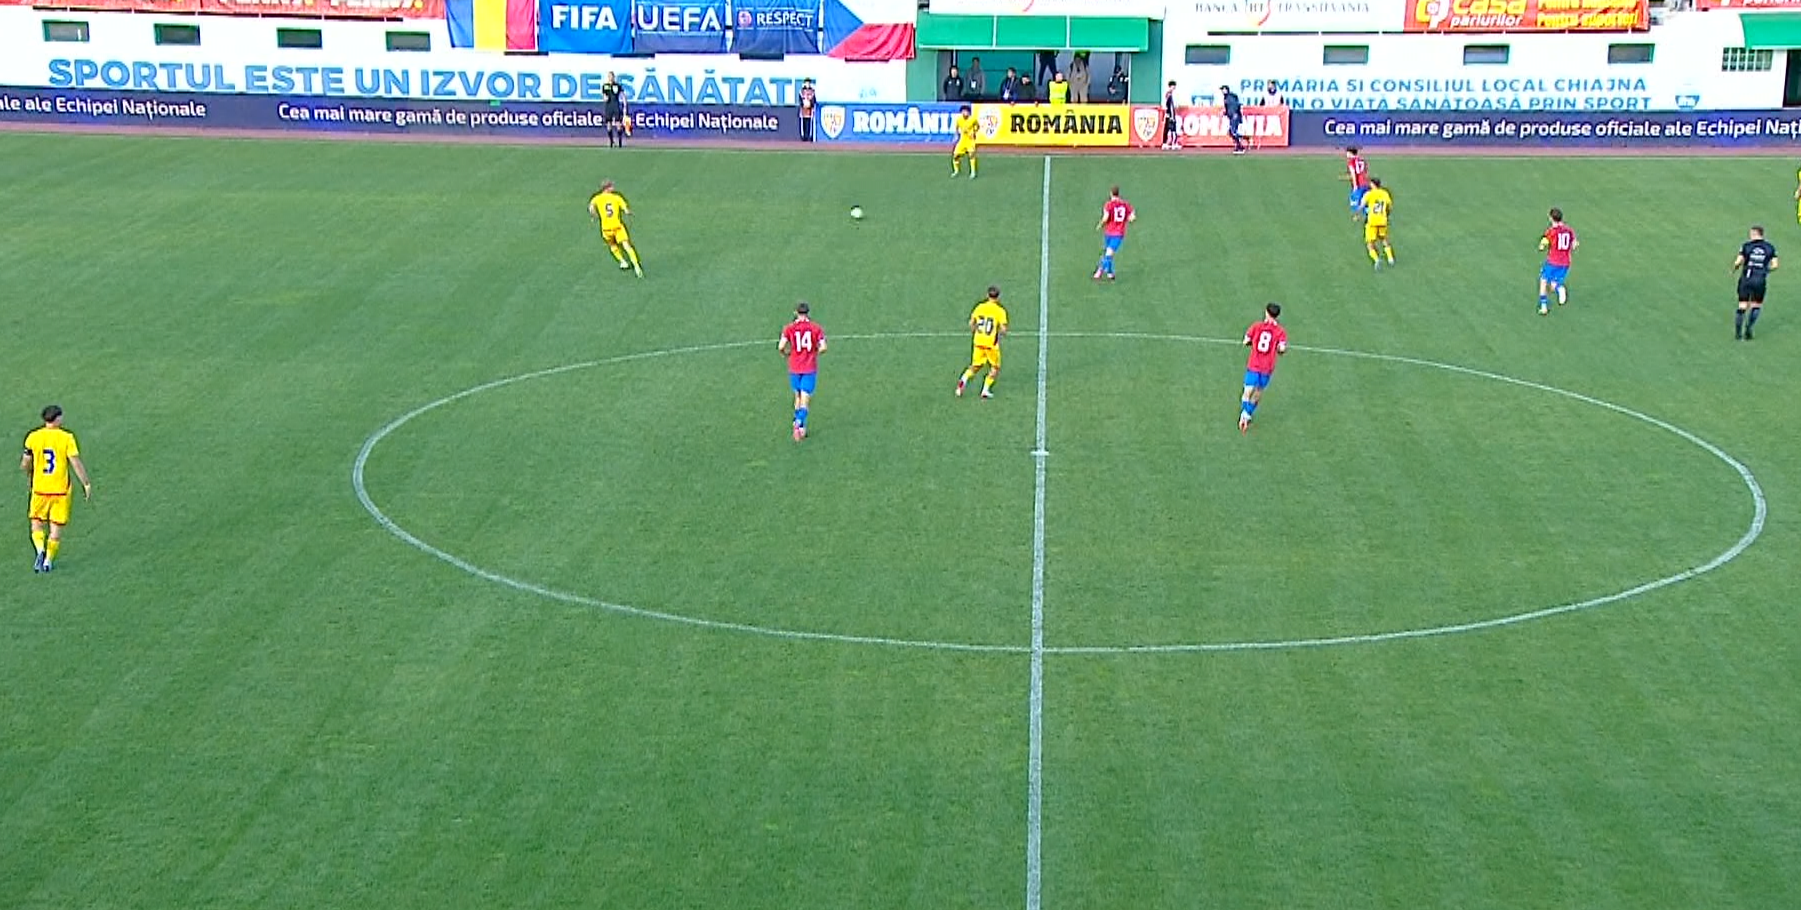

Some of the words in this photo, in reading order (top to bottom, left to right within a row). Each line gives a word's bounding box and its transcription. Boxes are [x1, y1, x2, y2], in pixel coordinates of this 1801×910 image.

[552, 5, 617, 30] FIFA
[638, 5, 721, 31] UEFA
[756, 11, 814, 28] RESPECT
[1450, 13, 1523, 29] pariurilor
[49, 58, 235, 91] SPORTUL
[245, 65, 346, 95] ESTE
[355, 68, 410, 96] UN
[421, 70, 541, 98] IZVOR
[552, 73, 602, 100] DE
[1370, 79, 1475, 92] CONSILIUL
[1482, 79, 1547, 92] LOCAL
[1554, 78, 1646, 92] CHIAJNA
[25, 97, 52, 111] ale
[56, 97, 118, 115] Echipei
[122, 99, 206, 120] Naționale
[1529, 97, 1577, 109] PRIN
[1584, 97, 1652, 110] SPORT
[279, 103, 309, 120] Cea
[314, 104, 345, 121] mai
[349, 107, 392, 122] mare
[396, 107, 442, 126] gamă
[446, 108, 467, 124] de
[471, 111, 538, 129] produse
[542, 110, 603, 127] oficiale
[635, 112, 694, 131] Echipei
[698, 113, 779, 134] Naționale
[1011, 110, 1123, 134] ROMÂNIA
[1325, 119, 1356, 135] Cea
[1360, 119, 1392, 135] mai
[1394, 121, 1439, 136] mare
[1442, 119, 1491, 138] gamă
[1494, 119, 1516, 136] de
[1520, 122, 1592, 139] produse
[1595, 119, 1661, 136] oficiale
[1665, 120, 1692, 136] ale
[1696, 119, 1761, 138] Echipei
[605, 203, 614, 218] 5
[1114, 206, 1126, 221] 13
[1373, 201, 1384, 214] 21
[1557, 232, 1571, 250] 10
[977, 316, 993, 336] 20
[794, 331, 812, 352] 14
[1257, 331, 1271, 353] 8
[43, 449, 55, 474] 3
